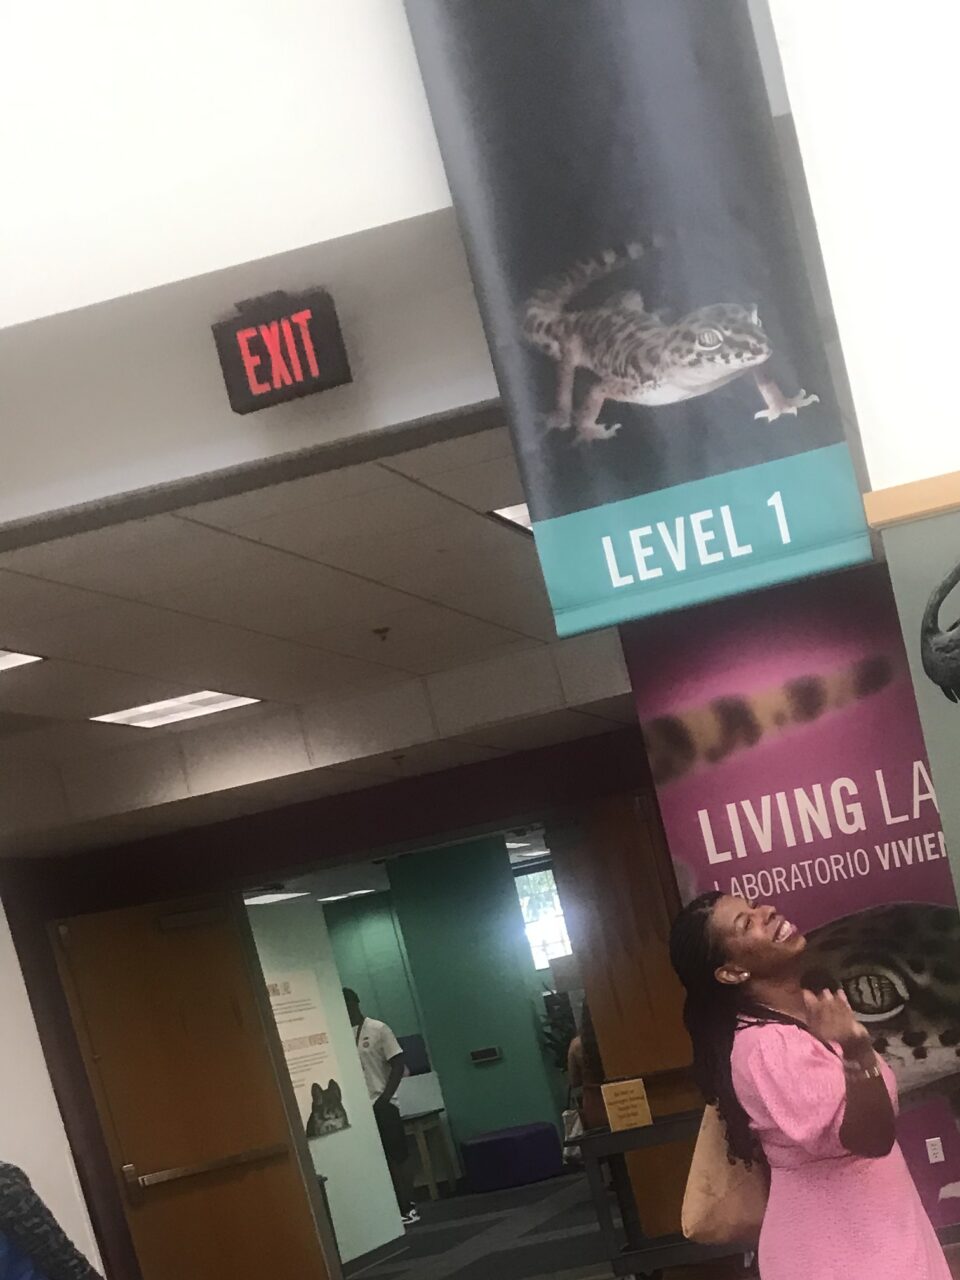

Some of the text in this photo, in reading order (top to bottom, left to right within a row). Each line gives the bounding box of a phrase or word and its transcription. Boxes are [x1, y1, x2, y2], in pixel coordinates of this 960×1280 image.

[236, 309, 320, 396] EXIT
[602, 490, 792, 588] LEVEL 1
[697, 777, 867, 865] LIVING
